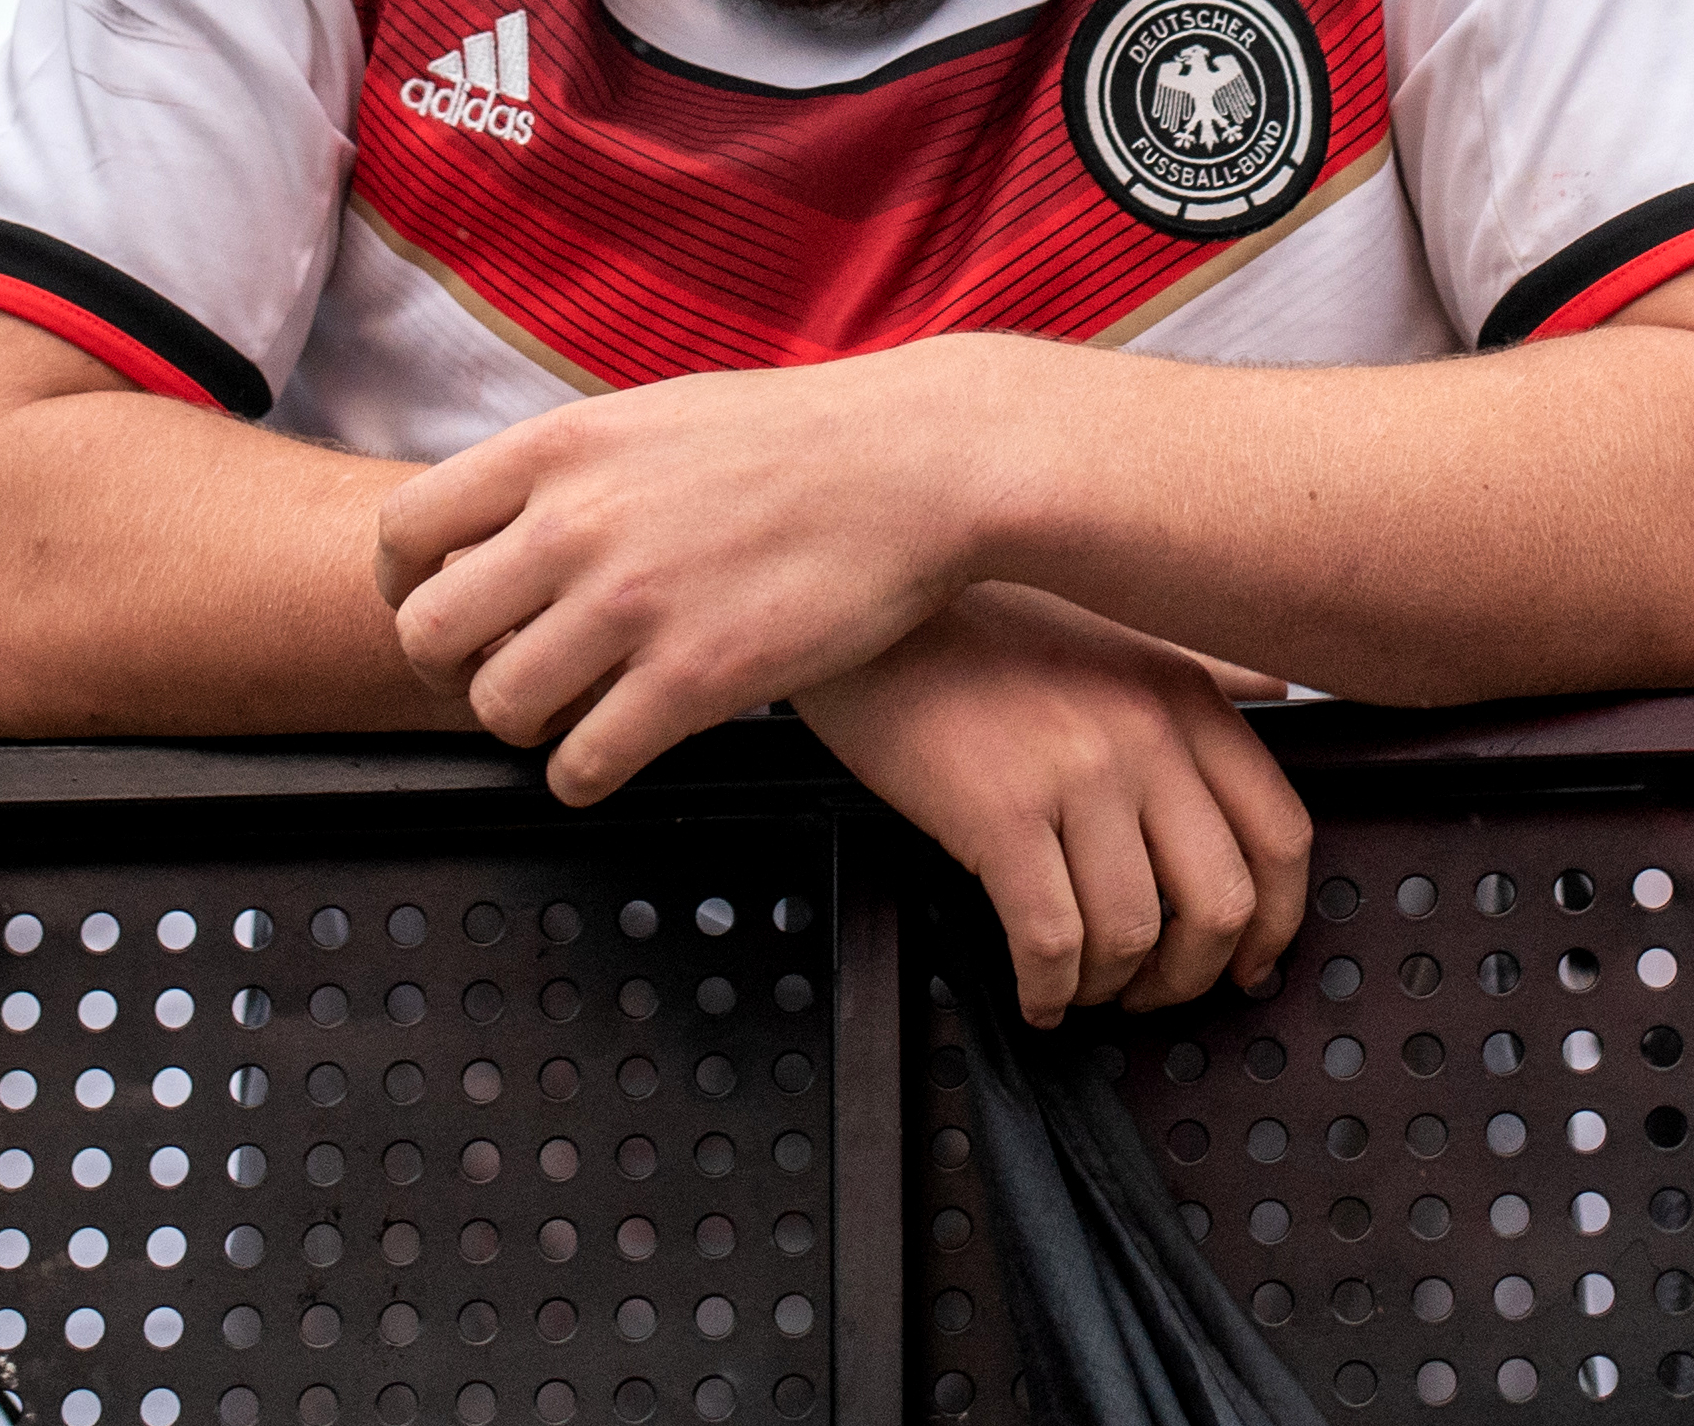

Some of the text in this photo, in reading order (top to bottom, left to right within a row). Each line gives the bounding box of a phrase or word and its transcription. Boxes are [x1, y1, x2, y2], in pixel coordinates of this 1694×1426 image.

[1128, 9, 1258, 65] DEUTSCHER
[400, 77, 536, 146] adidas
[1131, 119, 1283, 189] FUSSBALL-BUND
